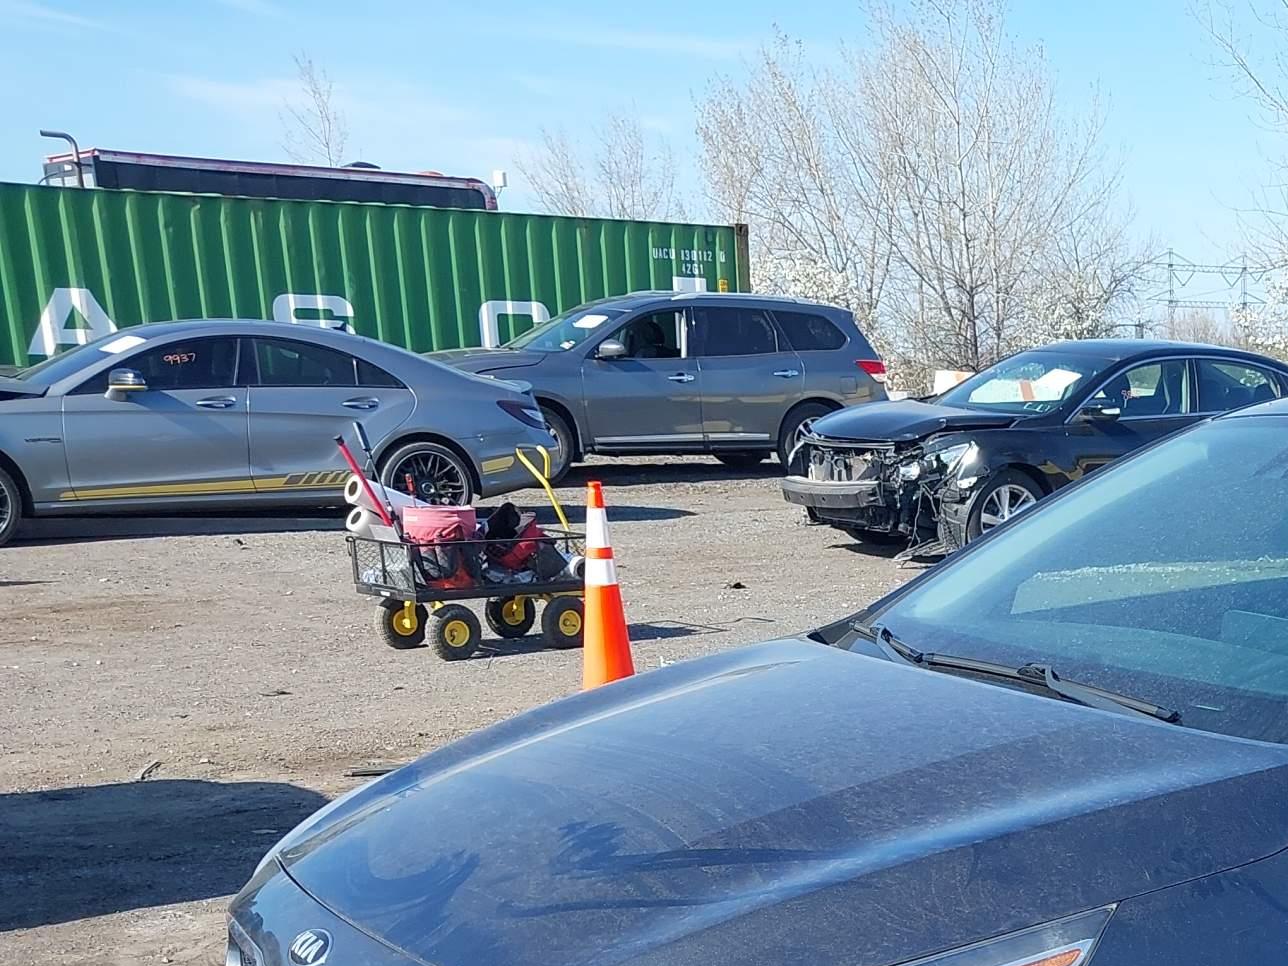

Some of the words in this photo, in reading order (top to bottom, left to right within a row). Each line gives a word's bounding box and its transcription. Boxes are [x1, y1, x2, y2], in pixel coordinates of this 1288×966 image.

[652, 247, 676, 260] UACU
[163, 352, 196, 365] 9937
[291, 930, 325, 964] KIA
